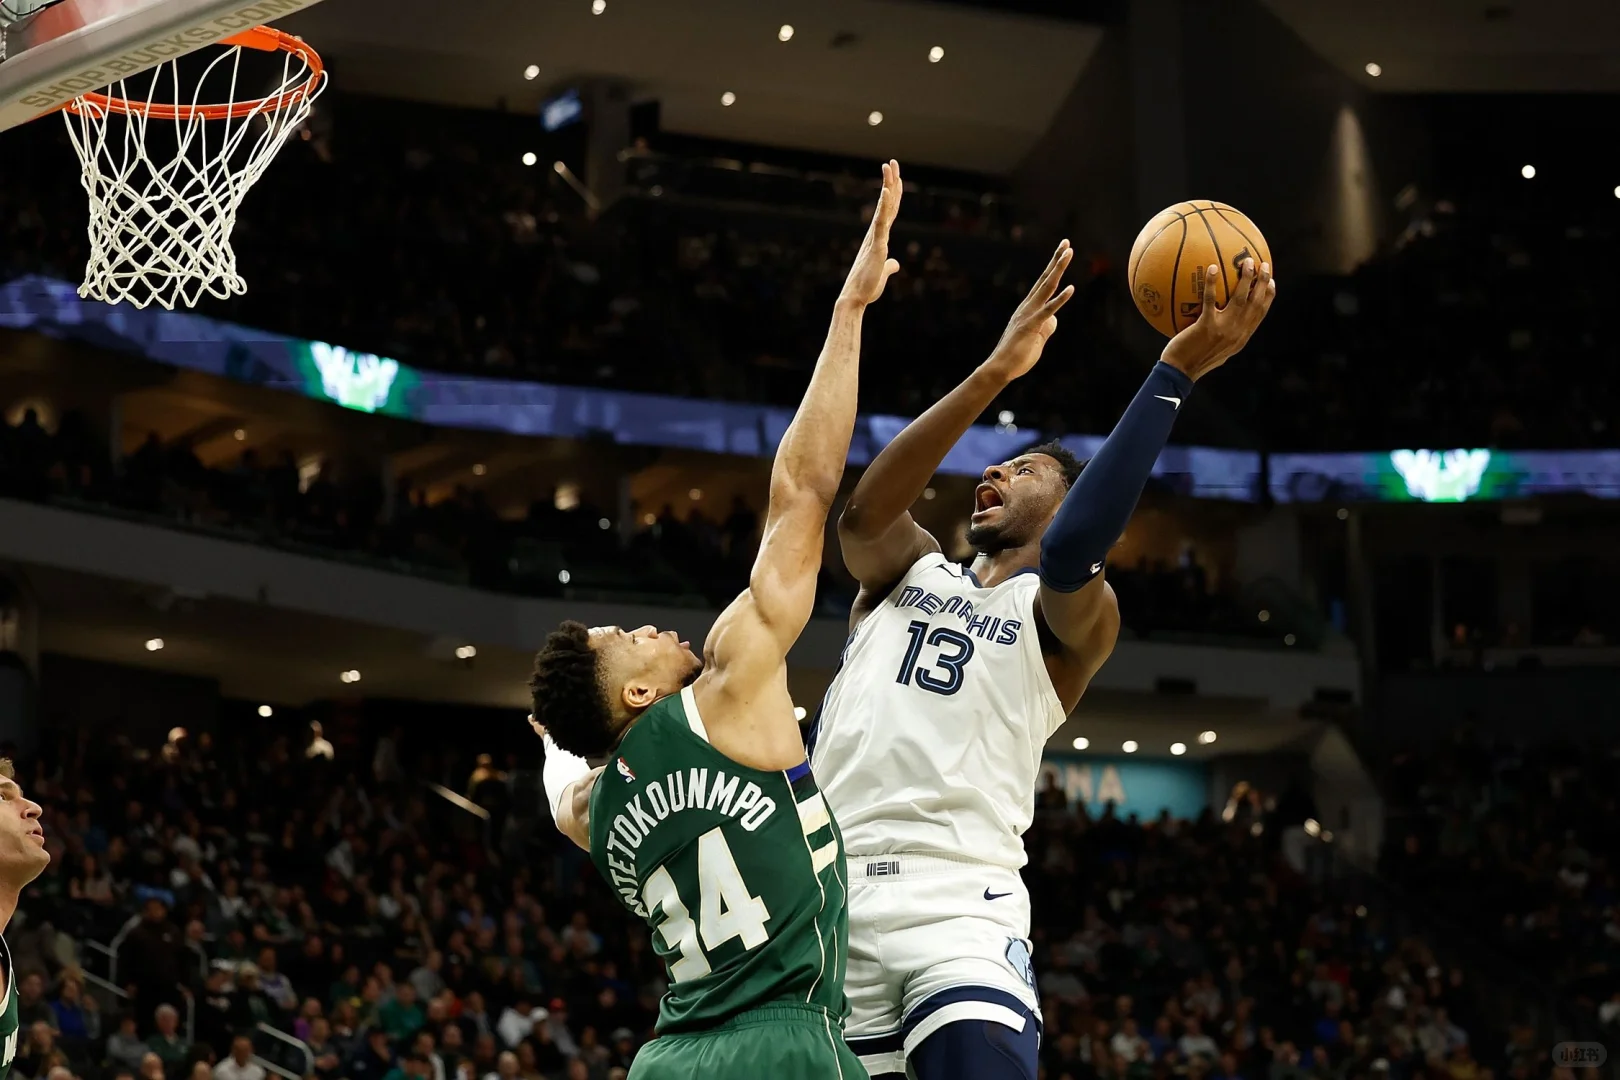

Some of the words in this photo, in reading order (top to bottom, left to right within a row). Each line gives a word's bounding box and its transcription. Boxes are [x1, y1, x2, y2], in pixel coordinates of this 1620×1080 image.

[894, 585, 1021, 645] MEMPHIS
[896, 620, 974, 696] 13
[641, 826, 771, 984] 34
